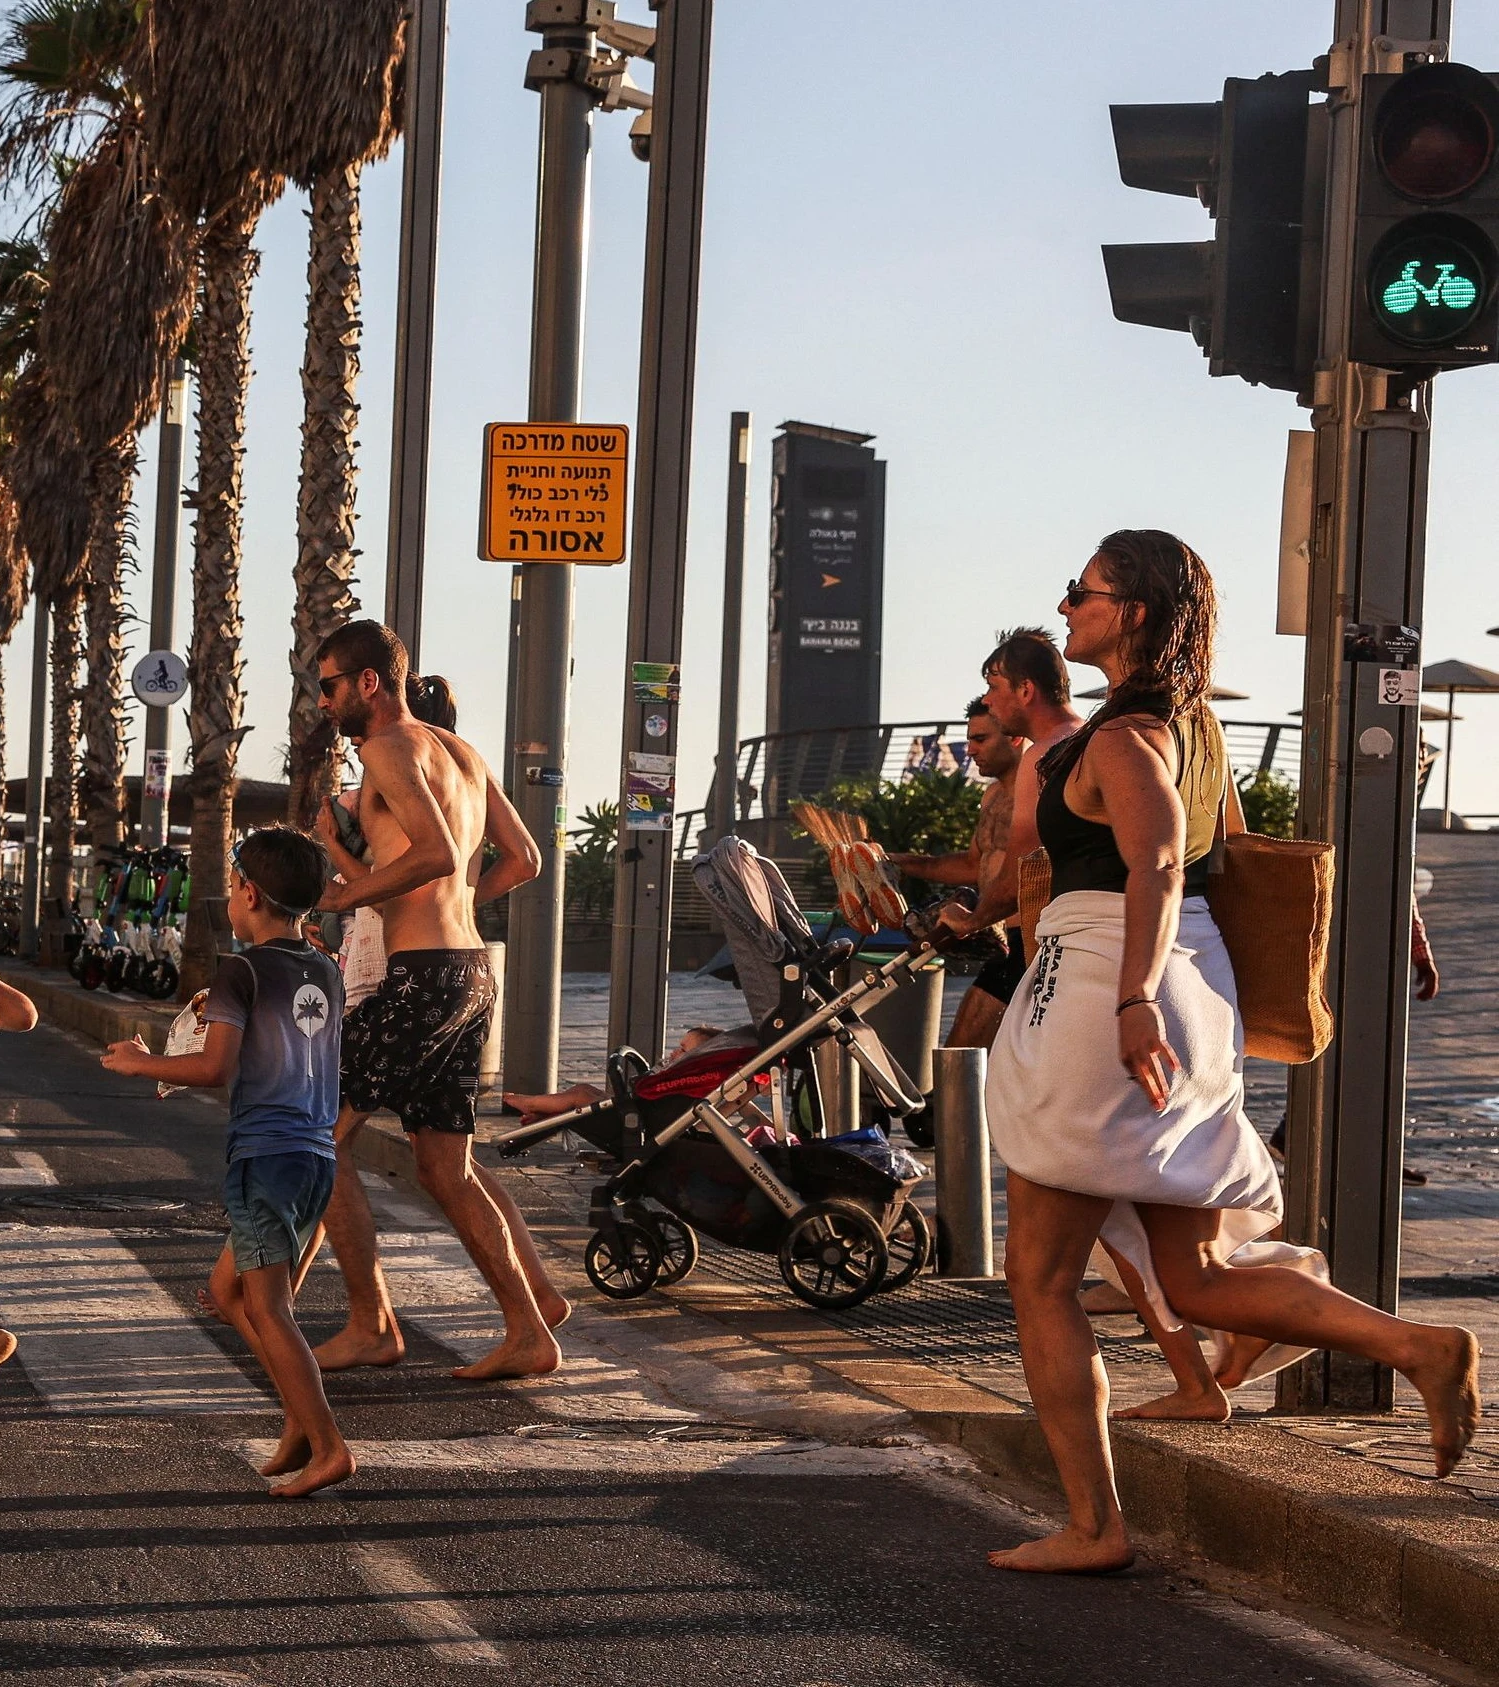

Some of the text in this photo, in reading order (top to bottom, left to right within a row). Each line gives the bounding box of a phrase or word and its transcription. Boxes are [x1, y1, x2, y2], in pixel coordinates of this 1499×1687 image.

[502, 432, 617, 453] שטח מדרכה
[506, 465, 611, 480] תנועה וחניית
[548, 488, 579, 501] רכב
[585, 486, 609, 502] כלי
[510, 506, 606, 523] רכב דו גלגלי
[509, 529, 604, 553] אסורה
[758, 1170, 793, 1210] UPPAbaby
